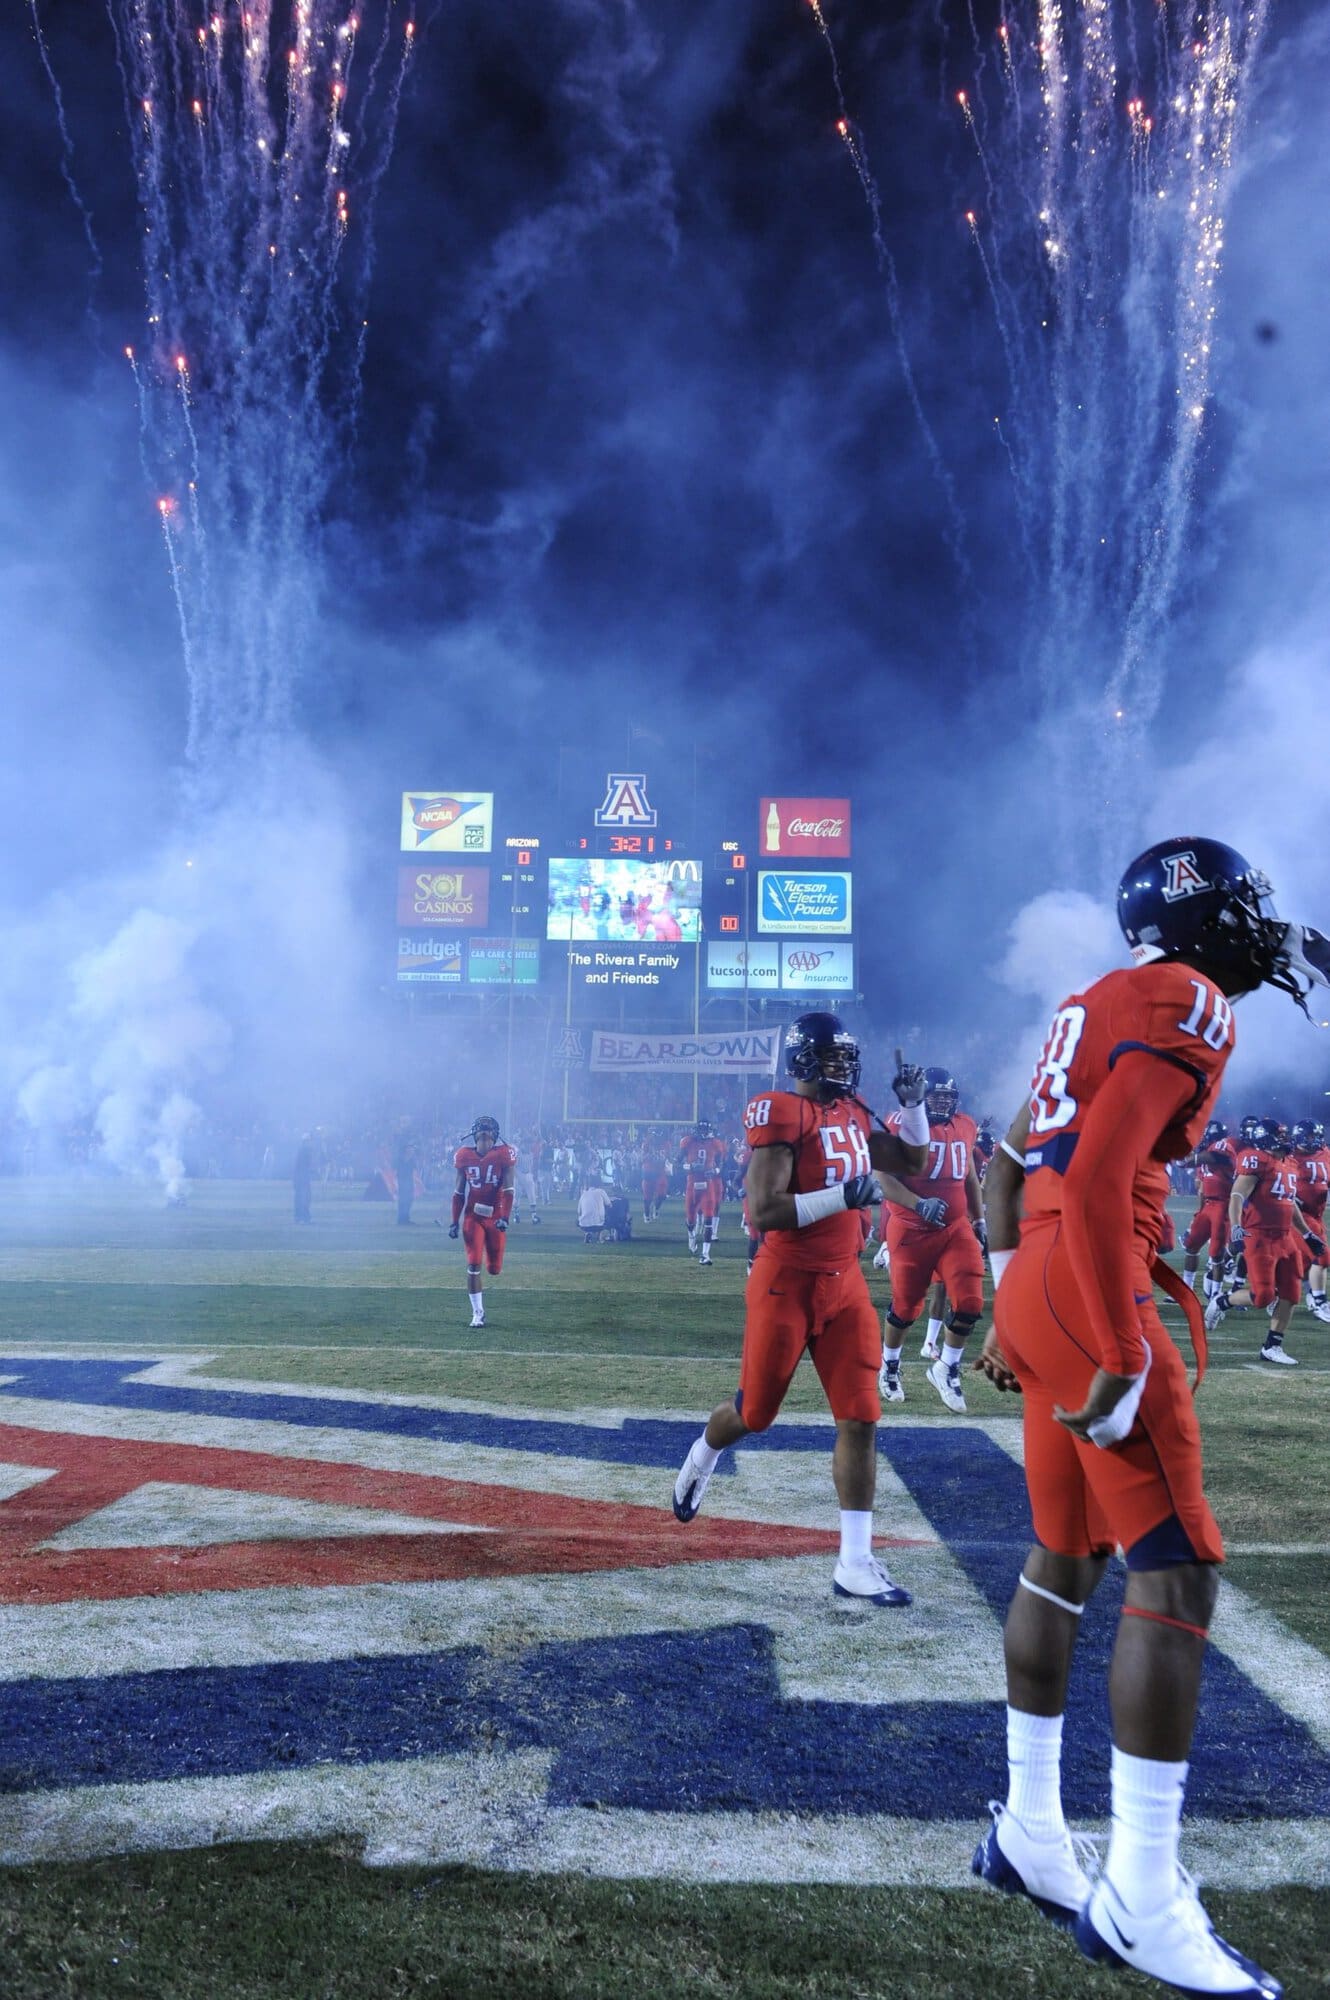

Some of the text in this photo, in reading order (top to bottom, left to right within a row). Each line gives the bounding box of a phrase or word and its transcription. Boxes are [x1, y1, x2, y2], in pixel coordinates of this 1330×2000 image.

[420, 810, 452, 823] NCAA
[506, 838, 540, 848] ARIZONA
[609, 836, 654, 853] 3:21
[722, 842, 739, 851] USC
[415, 873, 473, 901] SOL
[783, 880, 827, 892] Tucson
[788, 892, 839, 904] Electric
[414, 901, 473, 914] CASINOS
[792, 903, 839, 915] Power
[399, 938, 462, 961] Budget
[567, 953, 680, 969] The Rivera Family
[790, 951, 816, 971] AAA
[585, 972, 660, 985] and Friends
[710, 966, 777, 977] tucson.com
[804, 974, 849, 982] Insurance
[1177, 979, 1232, 1051] 18
[744, 1100, 772, 1129] 58
[819, 1119, 873, 1188] 58
[928, 1141, 967, 1179] 70
[1241, 1155, 1258, 1169] 45
[467, 1165, 498, 1189] 24
[1306, 1161, 1329, 1184] 71
[1270, 1172, 1298, 1201] 45
